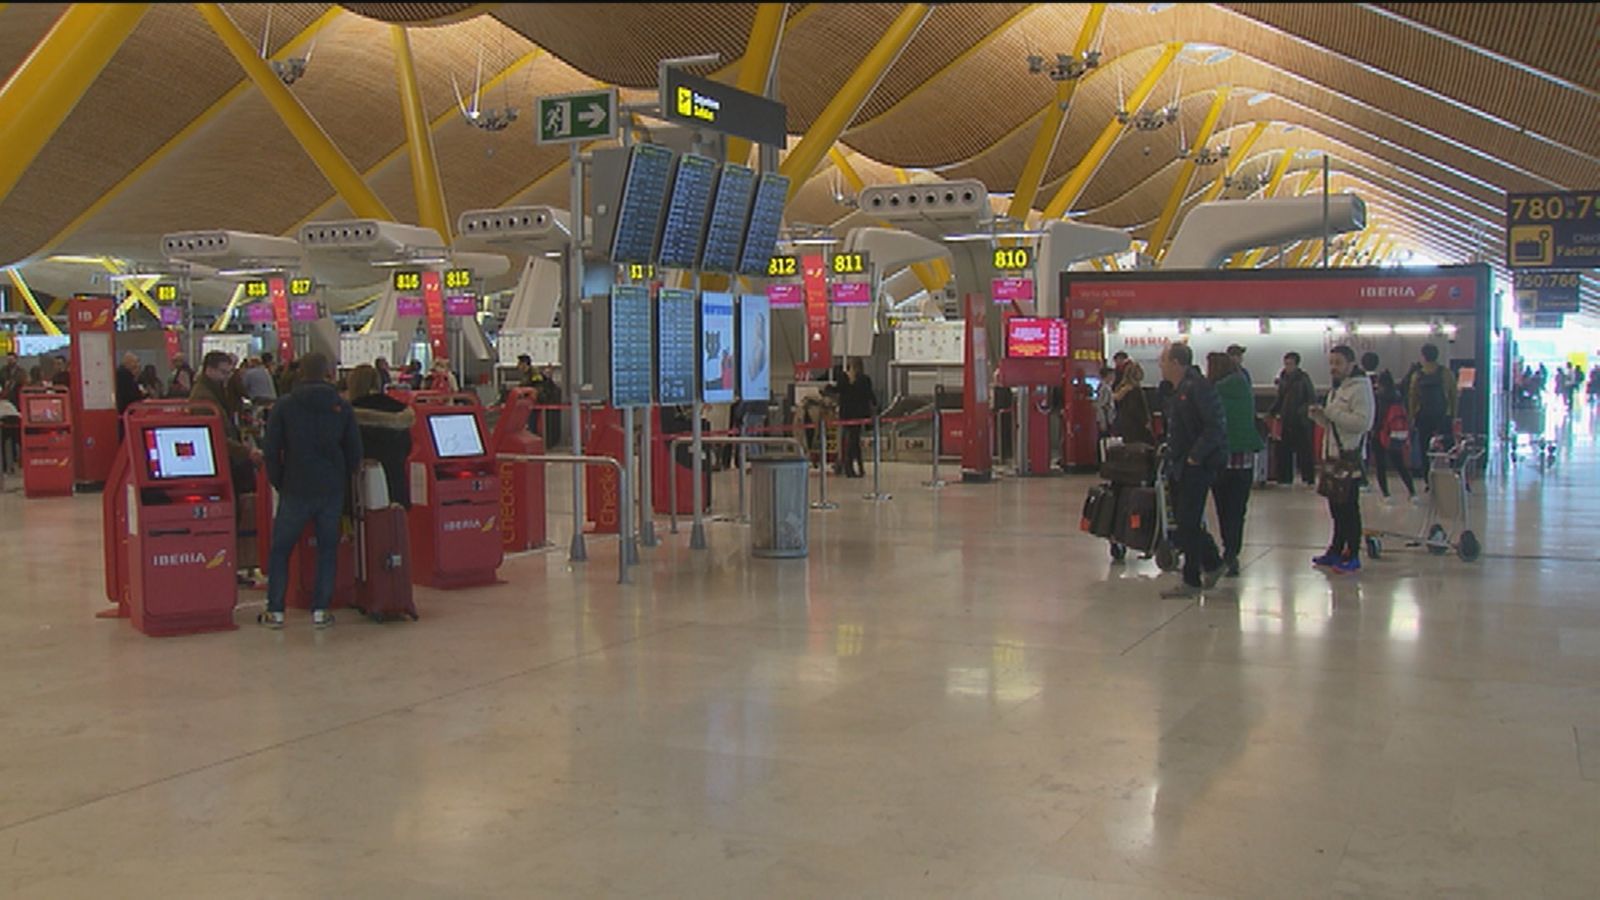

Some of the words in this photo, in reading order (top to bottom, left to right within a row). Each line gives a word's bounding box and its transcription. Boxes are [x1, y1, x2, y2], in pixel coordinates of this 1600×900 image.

[768, 258, 796, 275] 812
[834, 255, 863, 272] 811
[994, 250, 1027, 268] 810
[447, 271, 470, 287] 815
[1360, 286, 1416, 298] IBERIA
[443, 519, 481, 531] IBERIA
[153, 552, 206, 566] IBERIA
